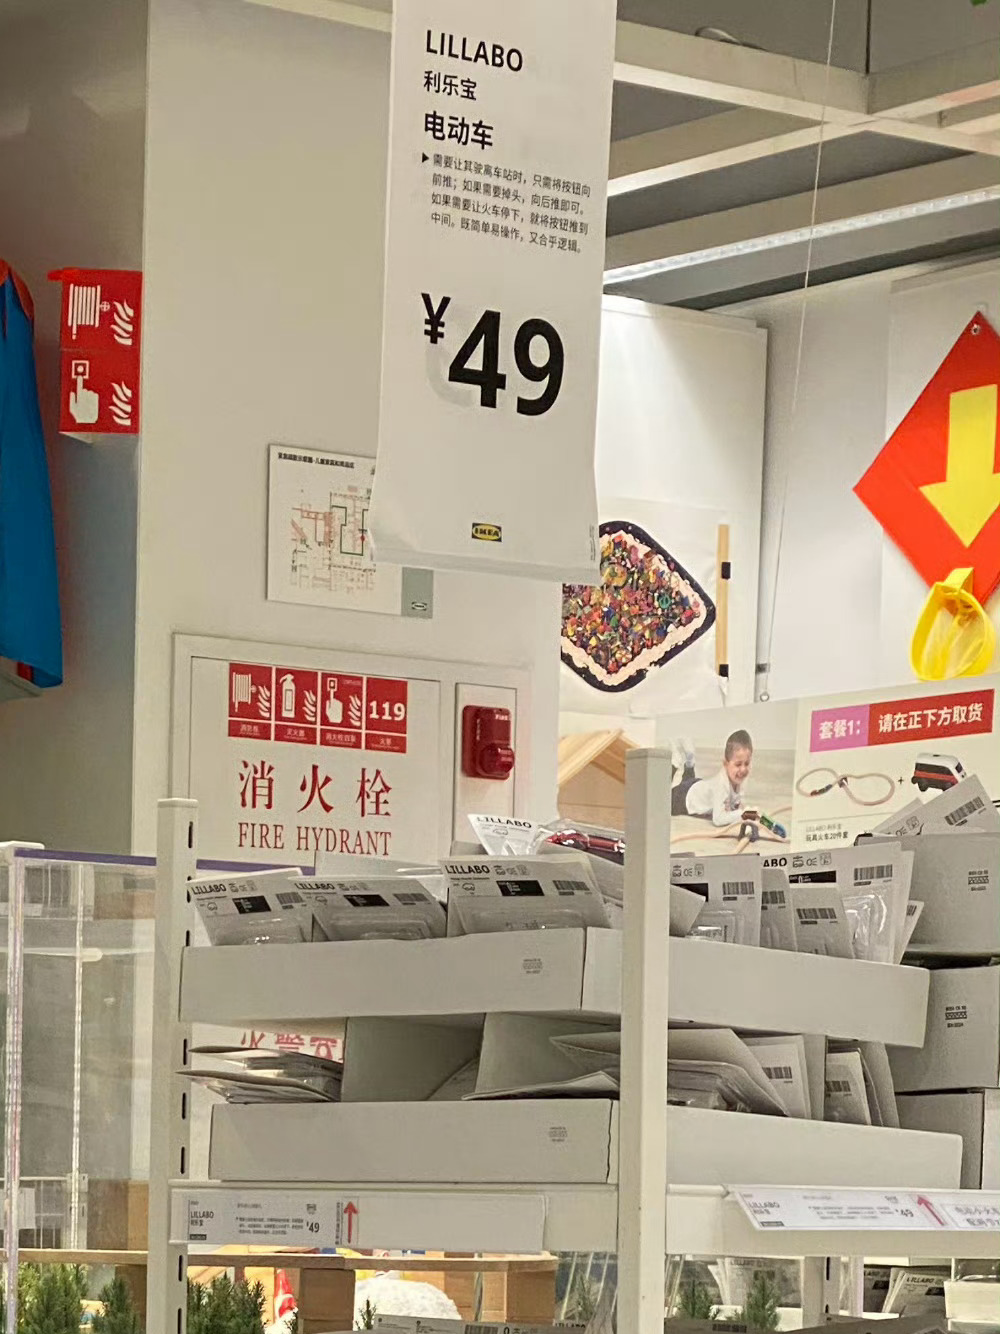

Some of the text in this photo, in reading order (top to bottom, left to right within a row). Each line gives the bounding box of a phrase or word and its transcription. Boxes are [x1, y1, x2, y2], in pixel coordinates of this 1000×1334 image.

[426, 30, 523, 71] LILLABO
[423, 70, 477, 100] 利乐宝
[424, 111, 493, 149] 电动车
[369, 700, 406, 721] 119
[878, 703, 983, 733] 请在正下方取货
[238, 760, 392, 818] 消火栓
[477, 816, 532, 829] LILLABO
[238, 822, 392, 856] FIRE HYDRANT
[445, 864, 490, 875] LILLABO
[191, 883, 227, 895] LILLABO
[294, 882, 336, 891] LILLABO
